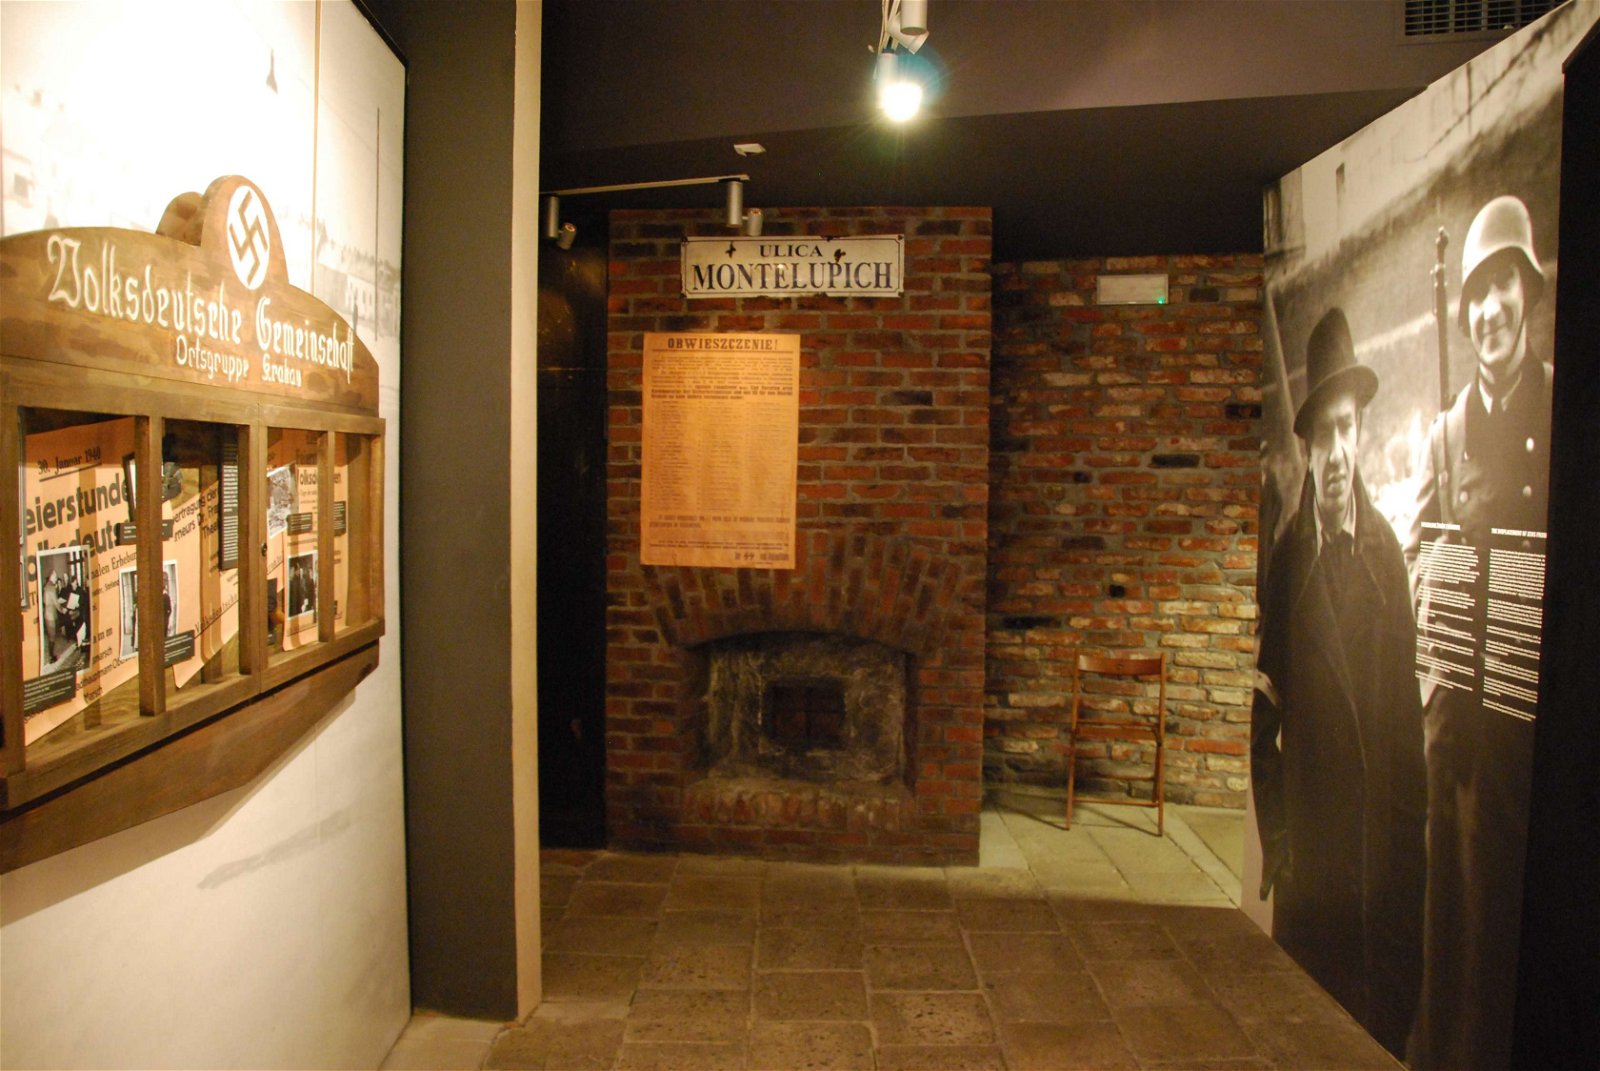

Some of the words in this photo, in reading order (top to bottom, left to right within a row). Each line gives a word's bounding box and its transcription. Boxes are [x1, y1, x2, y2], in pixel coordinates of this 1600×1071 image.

[759, 244, 823, 258] ULICA
[692, 262, 893, 291] MONTELUPICH
[47, 234, 242, 344] Volksdeutsche
[255, 296, 354, 385] Gemeinschaft
[176, 334, 249, 383] Ortsgruppe
[262, 352, 303, 387] Krakau
[667, 338, 778, 351] OBWIESZCZENIE!
[26, 472, 129, 537] eierstunde
